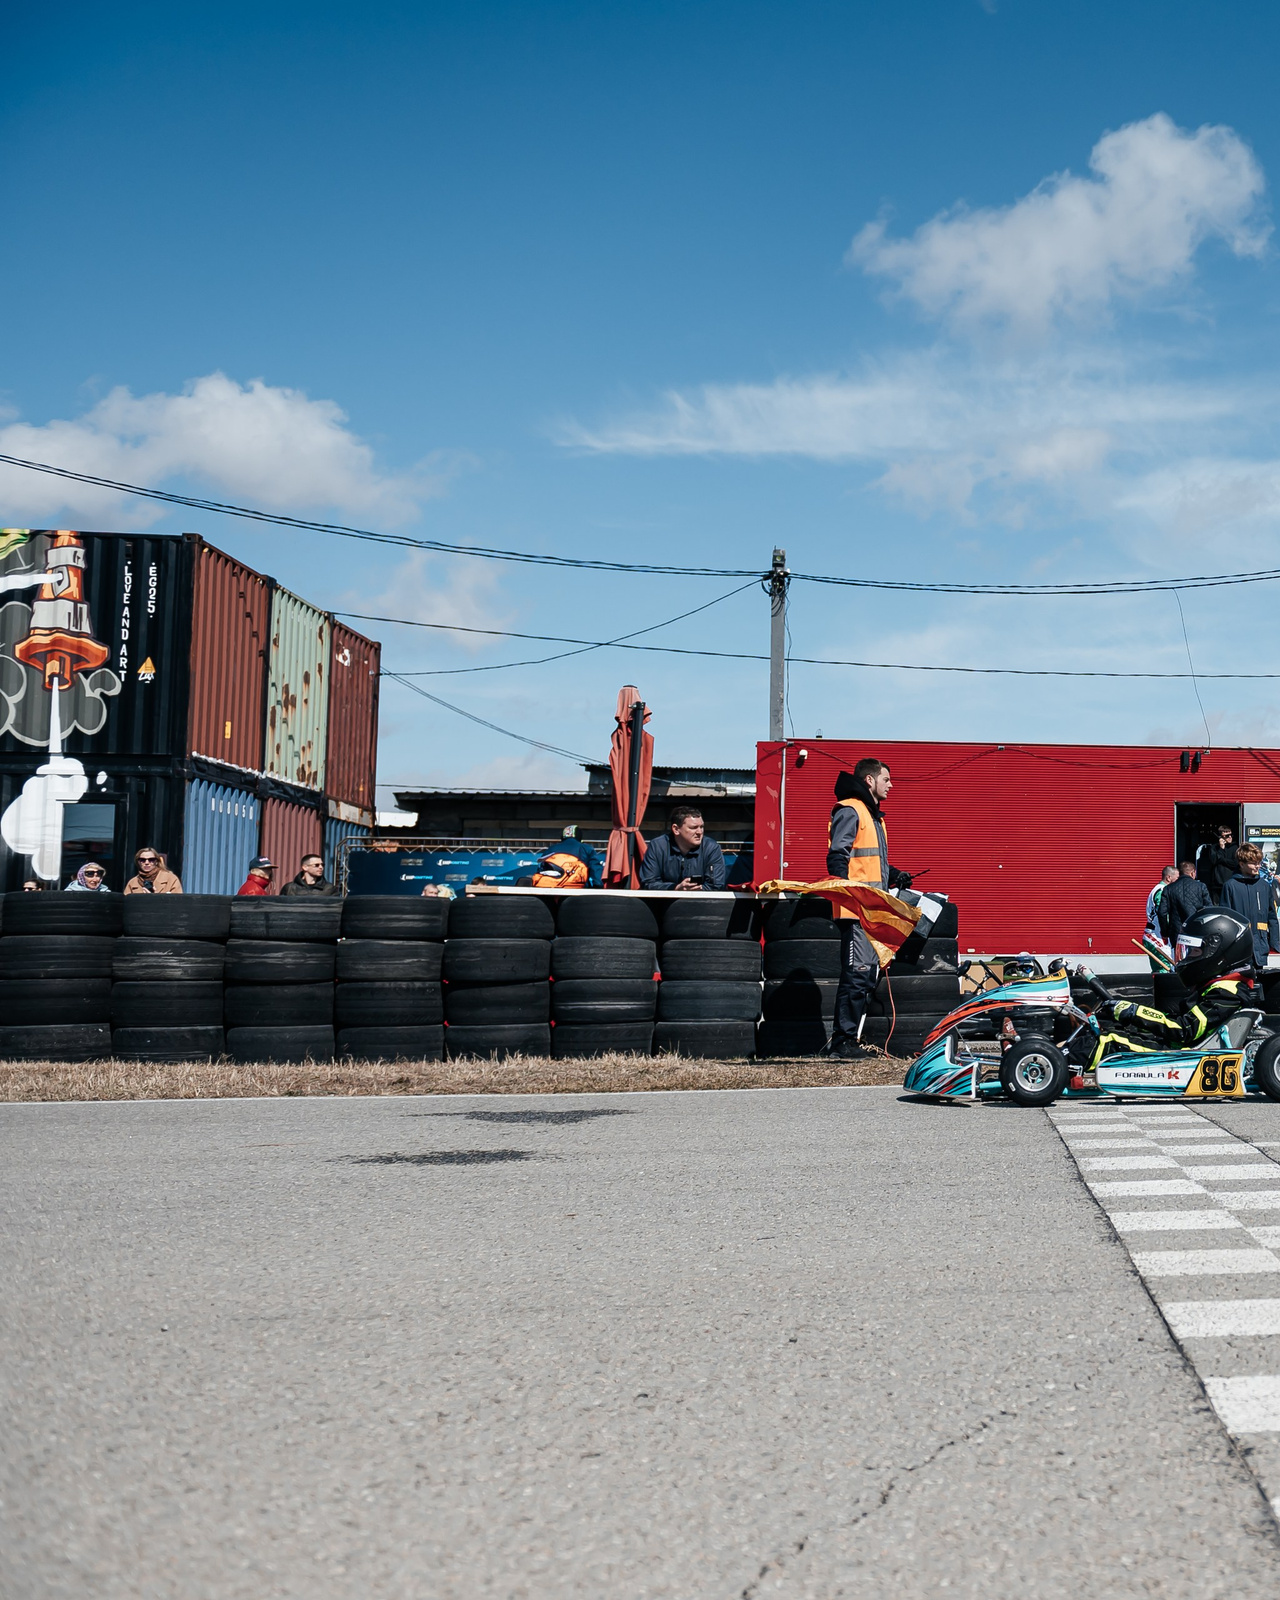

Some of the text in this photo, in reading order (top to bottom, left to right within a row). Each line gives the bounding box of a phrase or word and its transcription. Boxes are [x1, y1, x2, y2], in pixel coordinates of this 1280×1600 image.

[147, 566, 157, 614] EG25
[119, 565, 132, 682] LOVE AND ART
[1115, 1070, 1180, 1080] FORMULA K
[1200, 1058, 1240, 1093] 86
